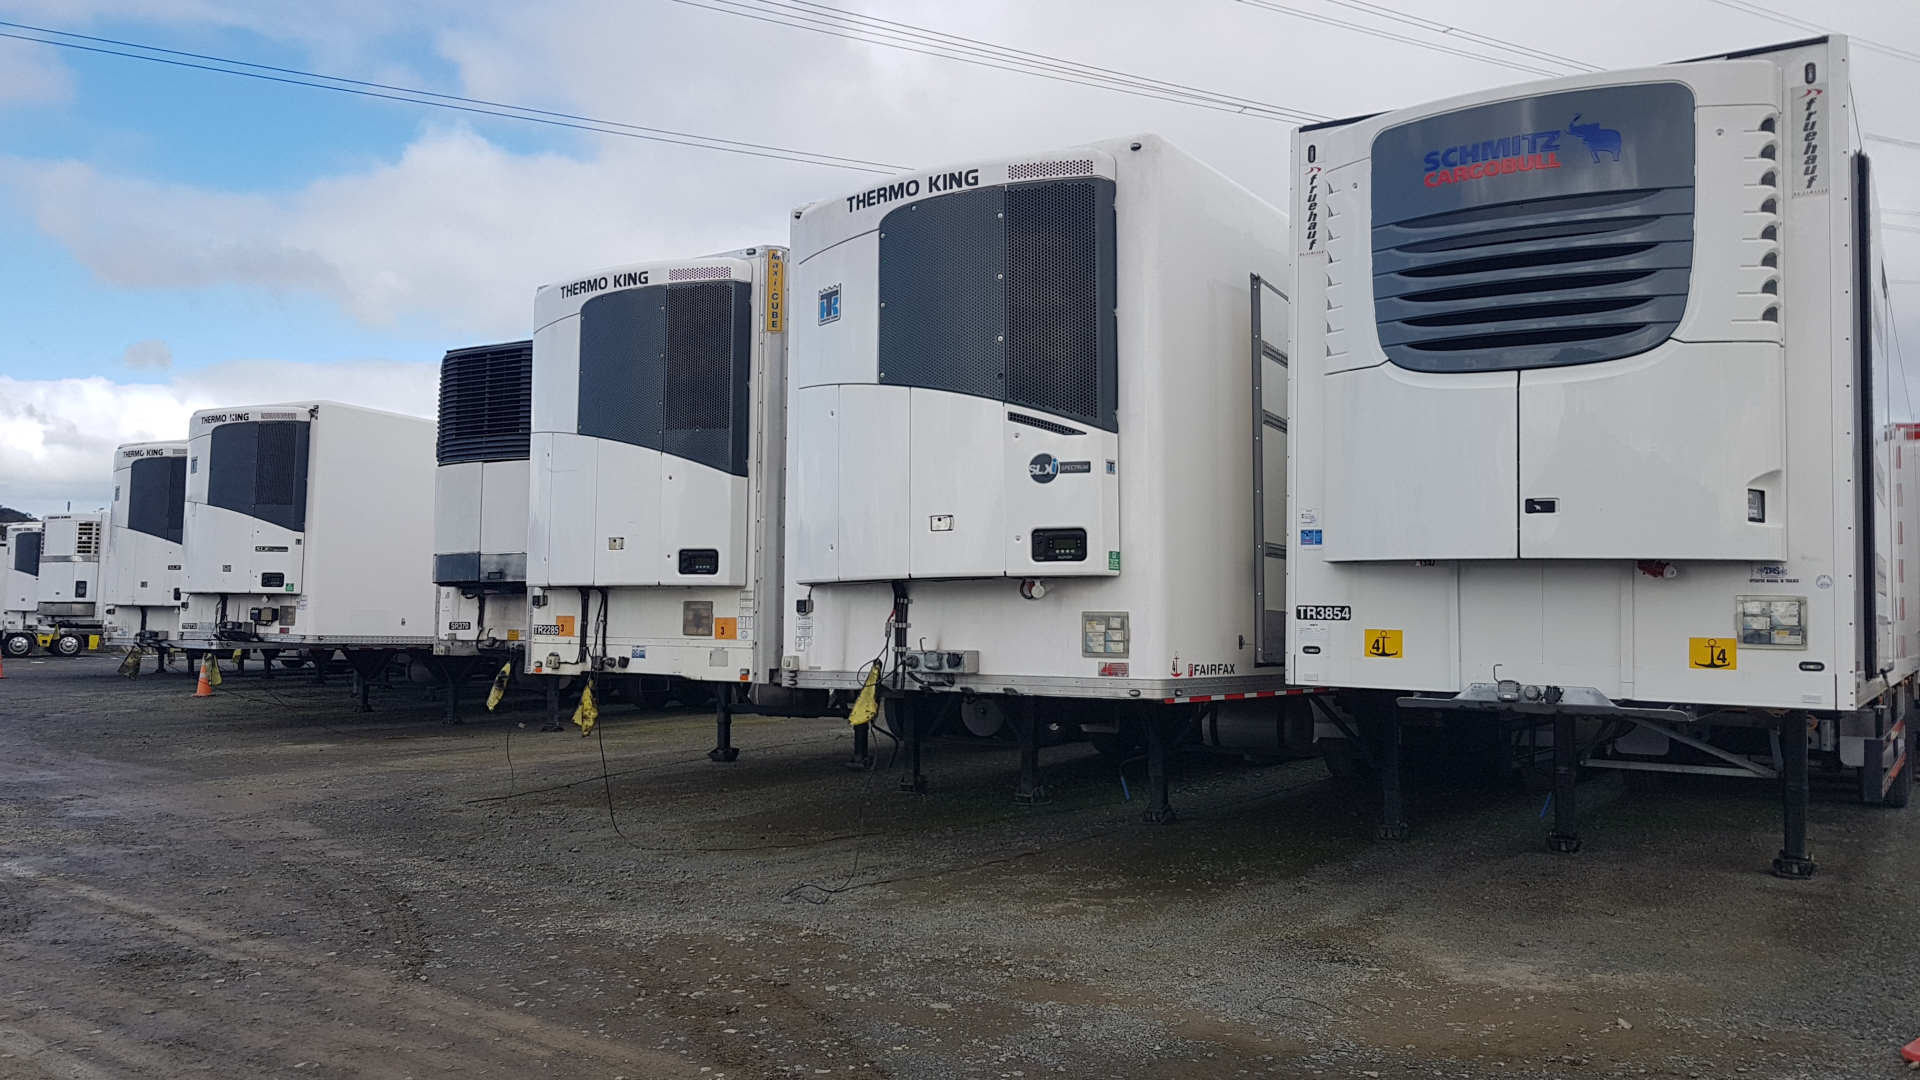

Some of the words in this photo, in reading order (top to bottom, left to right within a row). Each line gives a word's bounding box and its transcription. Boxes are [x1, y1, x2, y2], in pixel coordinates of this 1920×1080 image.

[1424, 130, 1561, 172] SCHMITZ
[1803, 97, 1818, 189] fruehauf
[1424, 152, 1561, 188] CARGOBULL
[846, 179, 920, 213] THERMO
[928, 169, 979, 193] KING
[1307, 174, 1318, 251] fruehauf
[560, 277, 608, 299] THERMO
[613, 271, 649, 288] KING
[201, 415, 227, 425] THERMO
[1297, 606, 1350, 620] TR3854
[450, 622, 469, 630] SR370
[534, 624, 559, 635] TR2285
[1372, 639, 1381, 652] 4
[1717, 648, 1727, 664] 4
[1194, 663, 1235, 676] FAIRFAX
